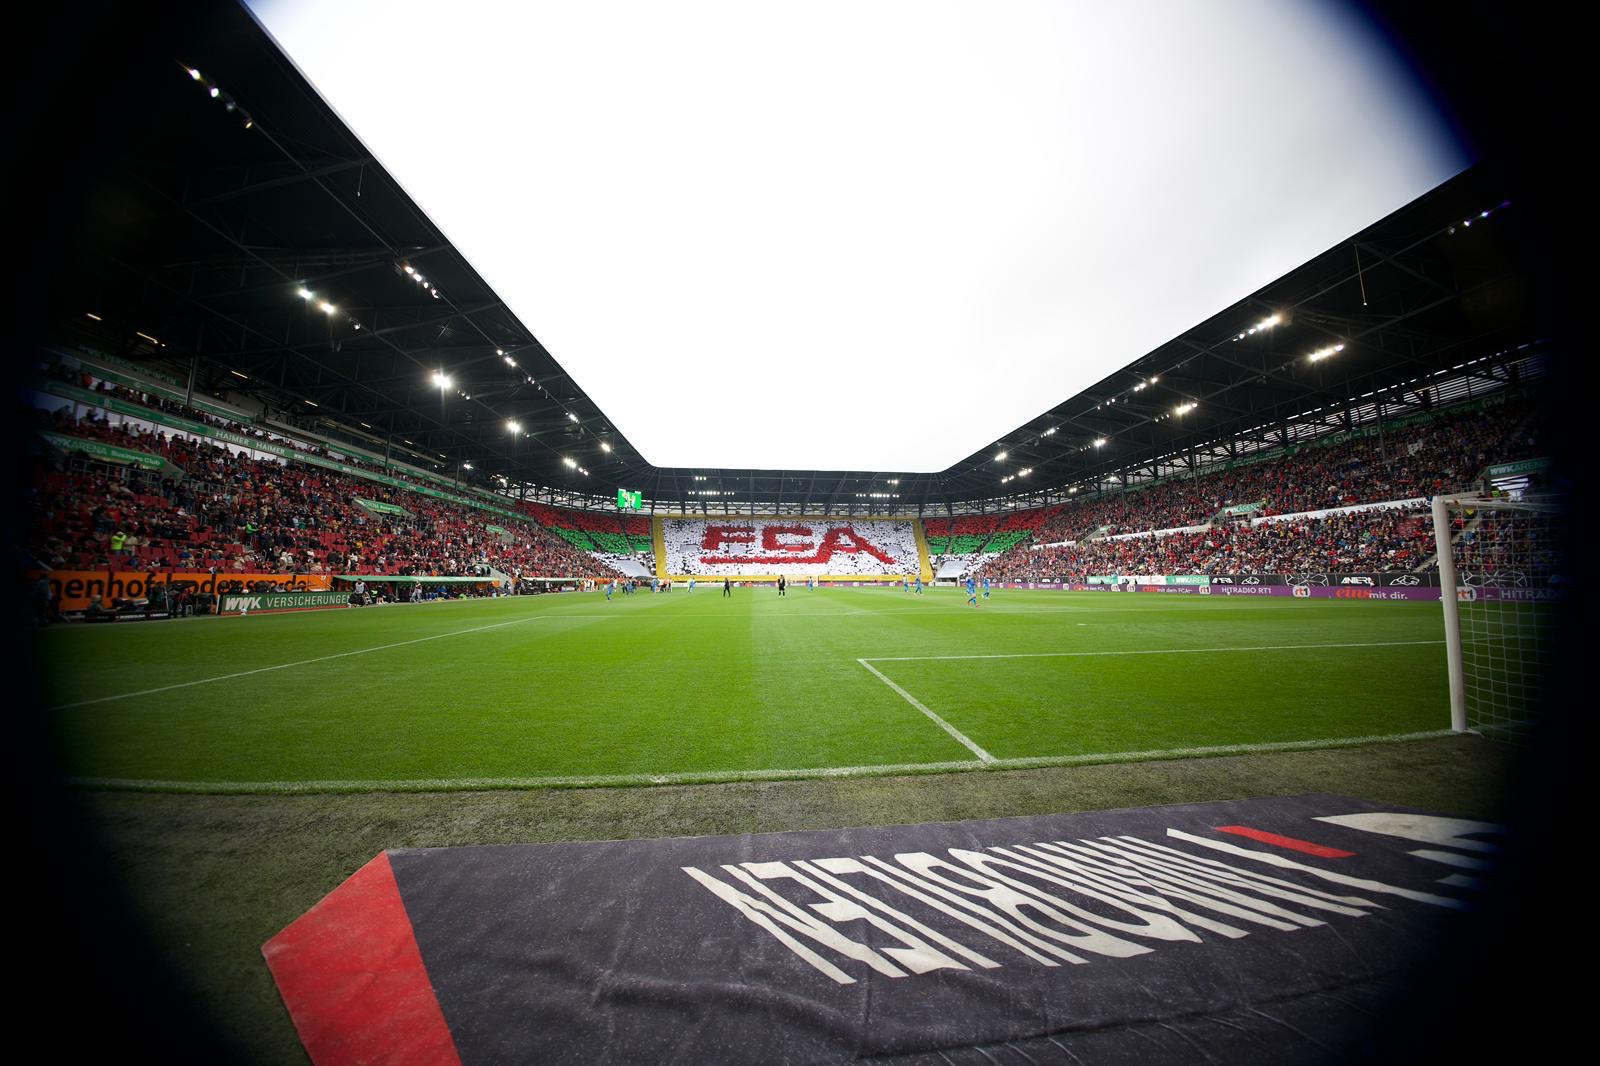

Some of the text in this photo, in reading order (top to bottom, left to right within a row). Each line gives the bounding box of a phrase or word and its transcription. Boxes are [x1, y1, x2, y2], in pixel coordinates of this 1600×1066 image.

[216, 430, 250, 447] HAIMER
[256, 441, 285, 454] HAIMER
[142, 456, 161, 467] Club
[1365, 505, 1386, 513] swa
[699, 524, 897, 565] FCA
[1221, 587, 1257, 595] HITRADIO
[1336, 587, 1408, 600] eins mit dir.
[225, 597, 262, 611] WWK
[682, 828, 1475, 986] IMMOBILIEN
